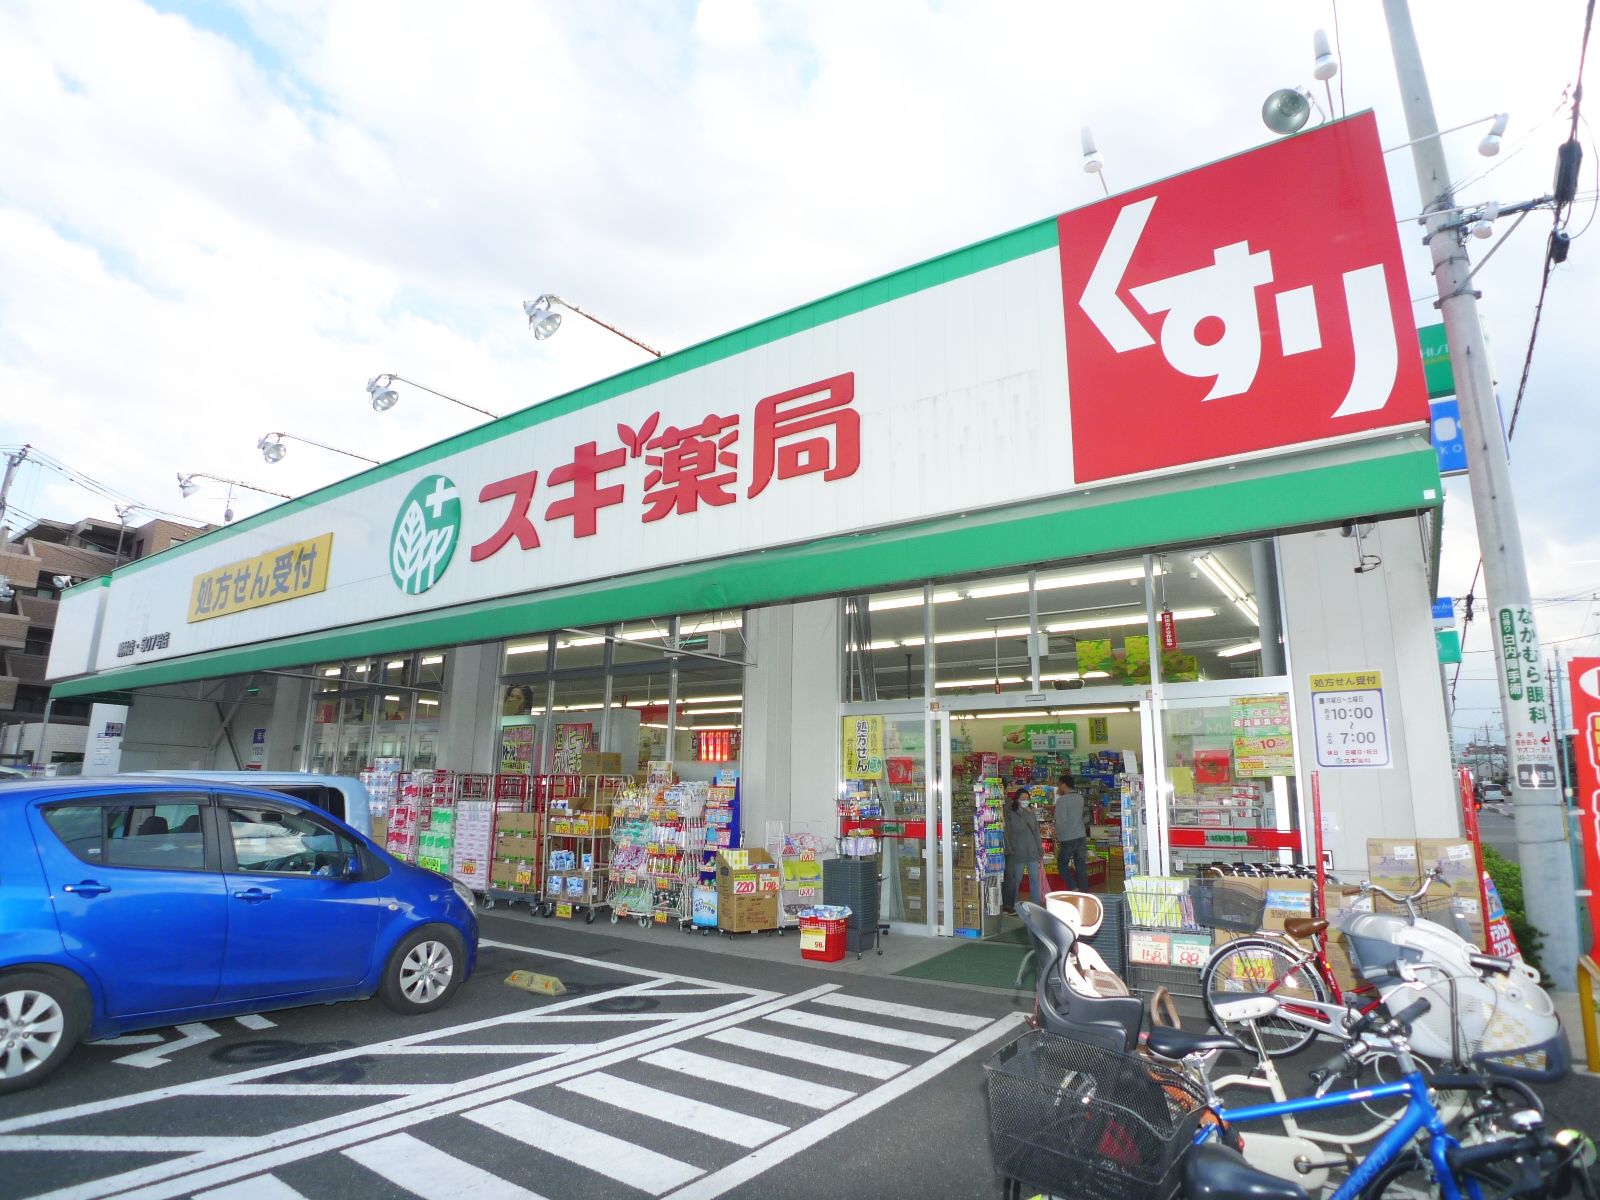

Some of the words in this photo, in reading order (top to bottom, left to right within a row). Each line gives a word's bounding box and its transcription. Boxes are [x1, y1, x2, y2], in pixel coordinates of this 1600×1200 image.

[1078, 195, 1398, 418] くすり
[470, 371, 861, 562] スギ薬局
[195, 543, 317, 616] 処方せん受付
[1313, 675, 1377, 688] 処方せん受付
[1516, 607, 1547, 725] なかむら眼科
[1331, 706, 1374, 720] 10:00
[856, 720, 869, 774] 処方せん
[1340, 731, 1376, 744] 7:00
[736, 881, 755, 893] 220
[1179, 951, 1200, 965] 88
